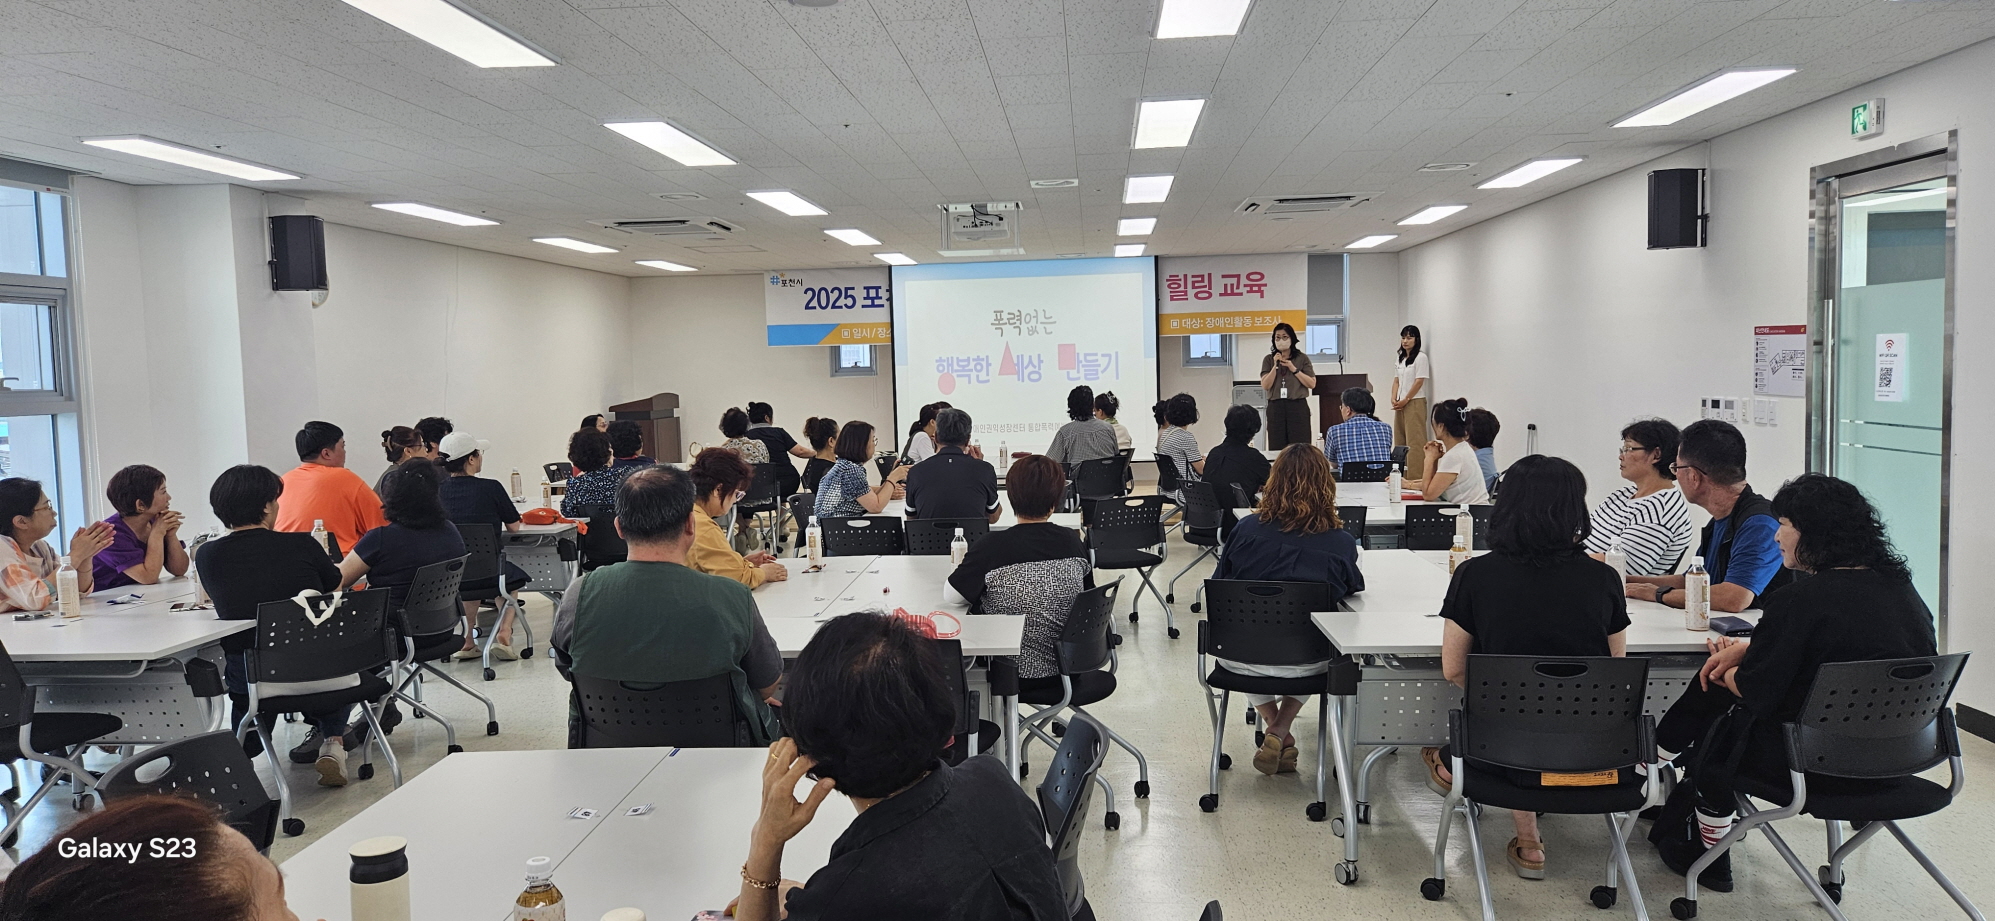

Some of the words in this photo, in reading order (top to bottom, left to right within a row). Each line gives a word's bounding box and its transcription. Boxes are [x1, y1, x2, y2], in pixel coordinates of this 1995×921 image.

[1166, 272, 1213, 302] 힐링
[1219, 271, 1268, 299] 교육
[803, 287, 857, 310] 2025
[852, 328, 870, 339] 일시
[990, 309, 1057, 337] 폭력없는
[1182, 318, 1204, 329] 대상:
[1205, 316, 1253, 328] 장애인활동
